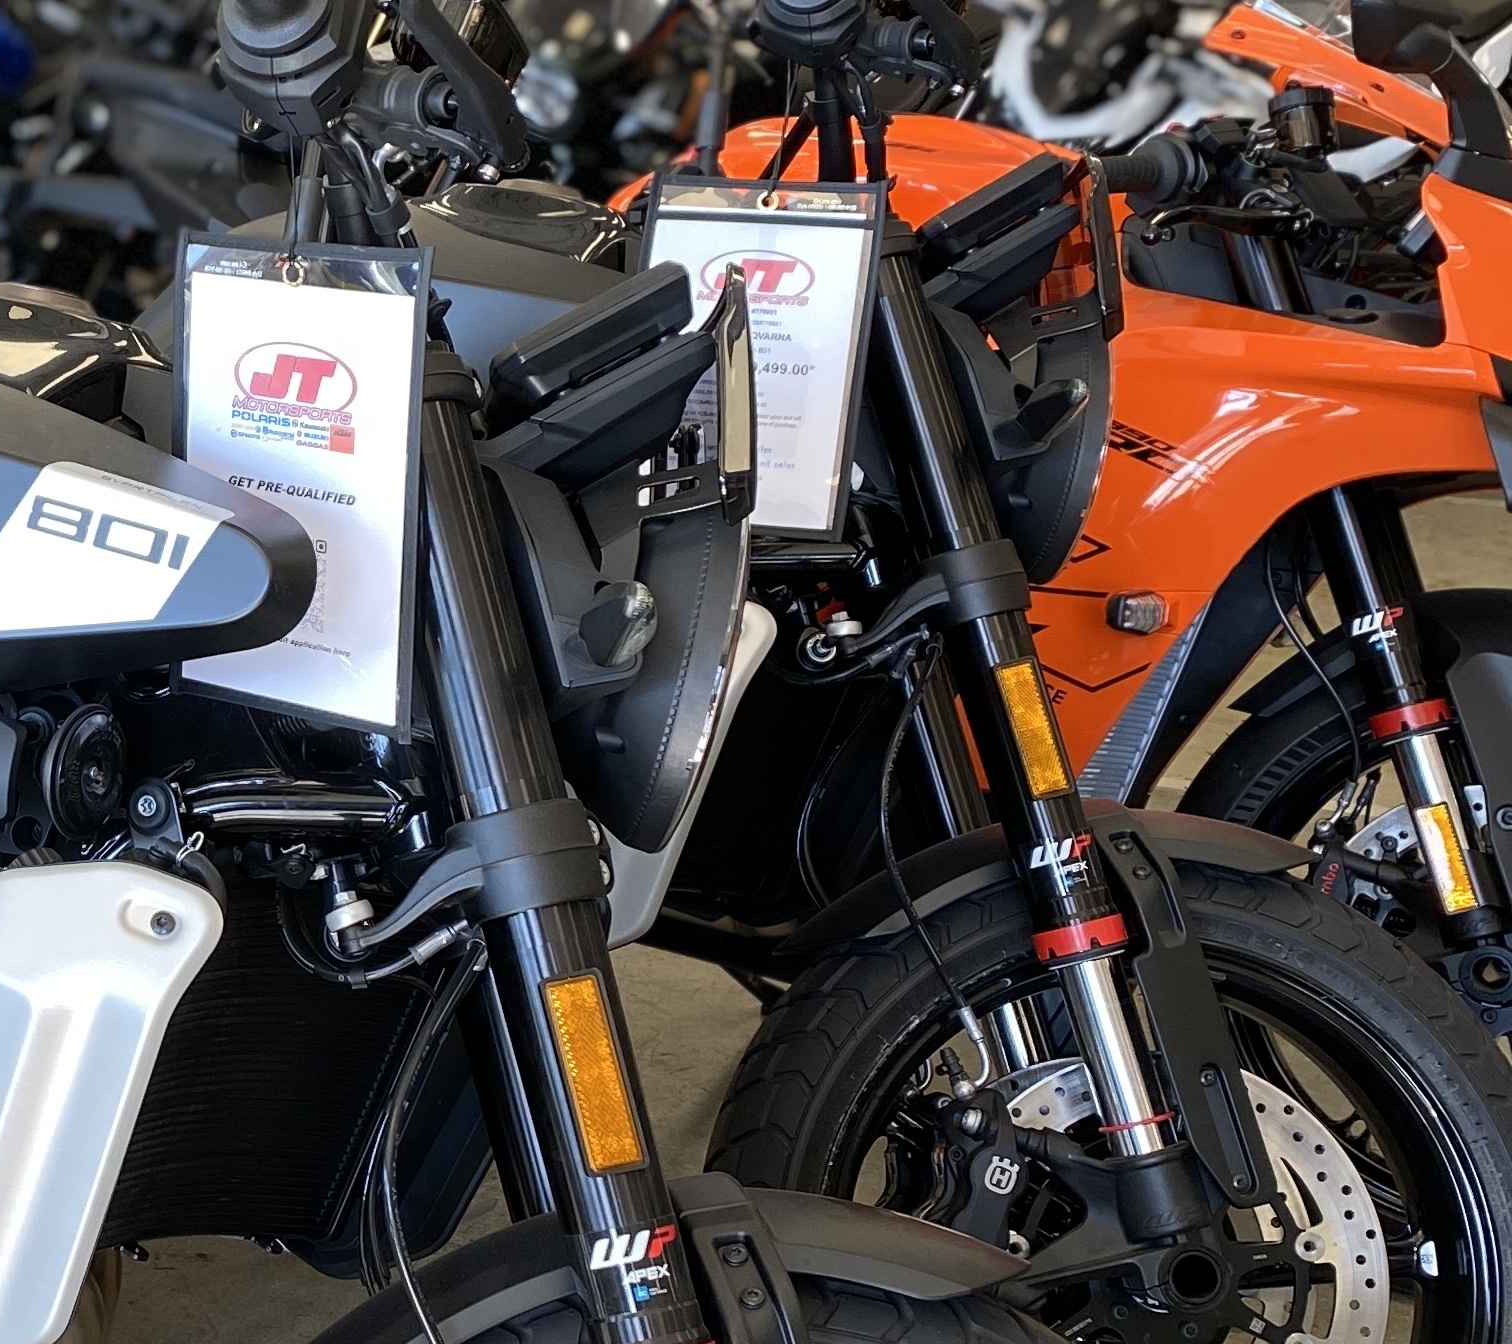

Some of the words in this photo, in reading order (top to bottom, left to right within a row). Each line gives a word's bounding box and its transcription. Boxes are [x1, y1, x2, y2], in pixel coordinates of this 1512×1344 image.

[250, 354, 337, 404] JT
[231, 410, 290, 427] POLARIS
[232, 395, 352, 425] MOTORSPORTS
[229, 475, 255, 489] GET
[257, 479, 357, 505] PRE-QUALIFIED
[27, 495, 189, 570] 801
[1352, 607, 1404, 636] WP
[1030, 833, 1092, 869] WP
[590, 1224, 677, 1270] WP
[623, 1264, 671, 1285] APEX
